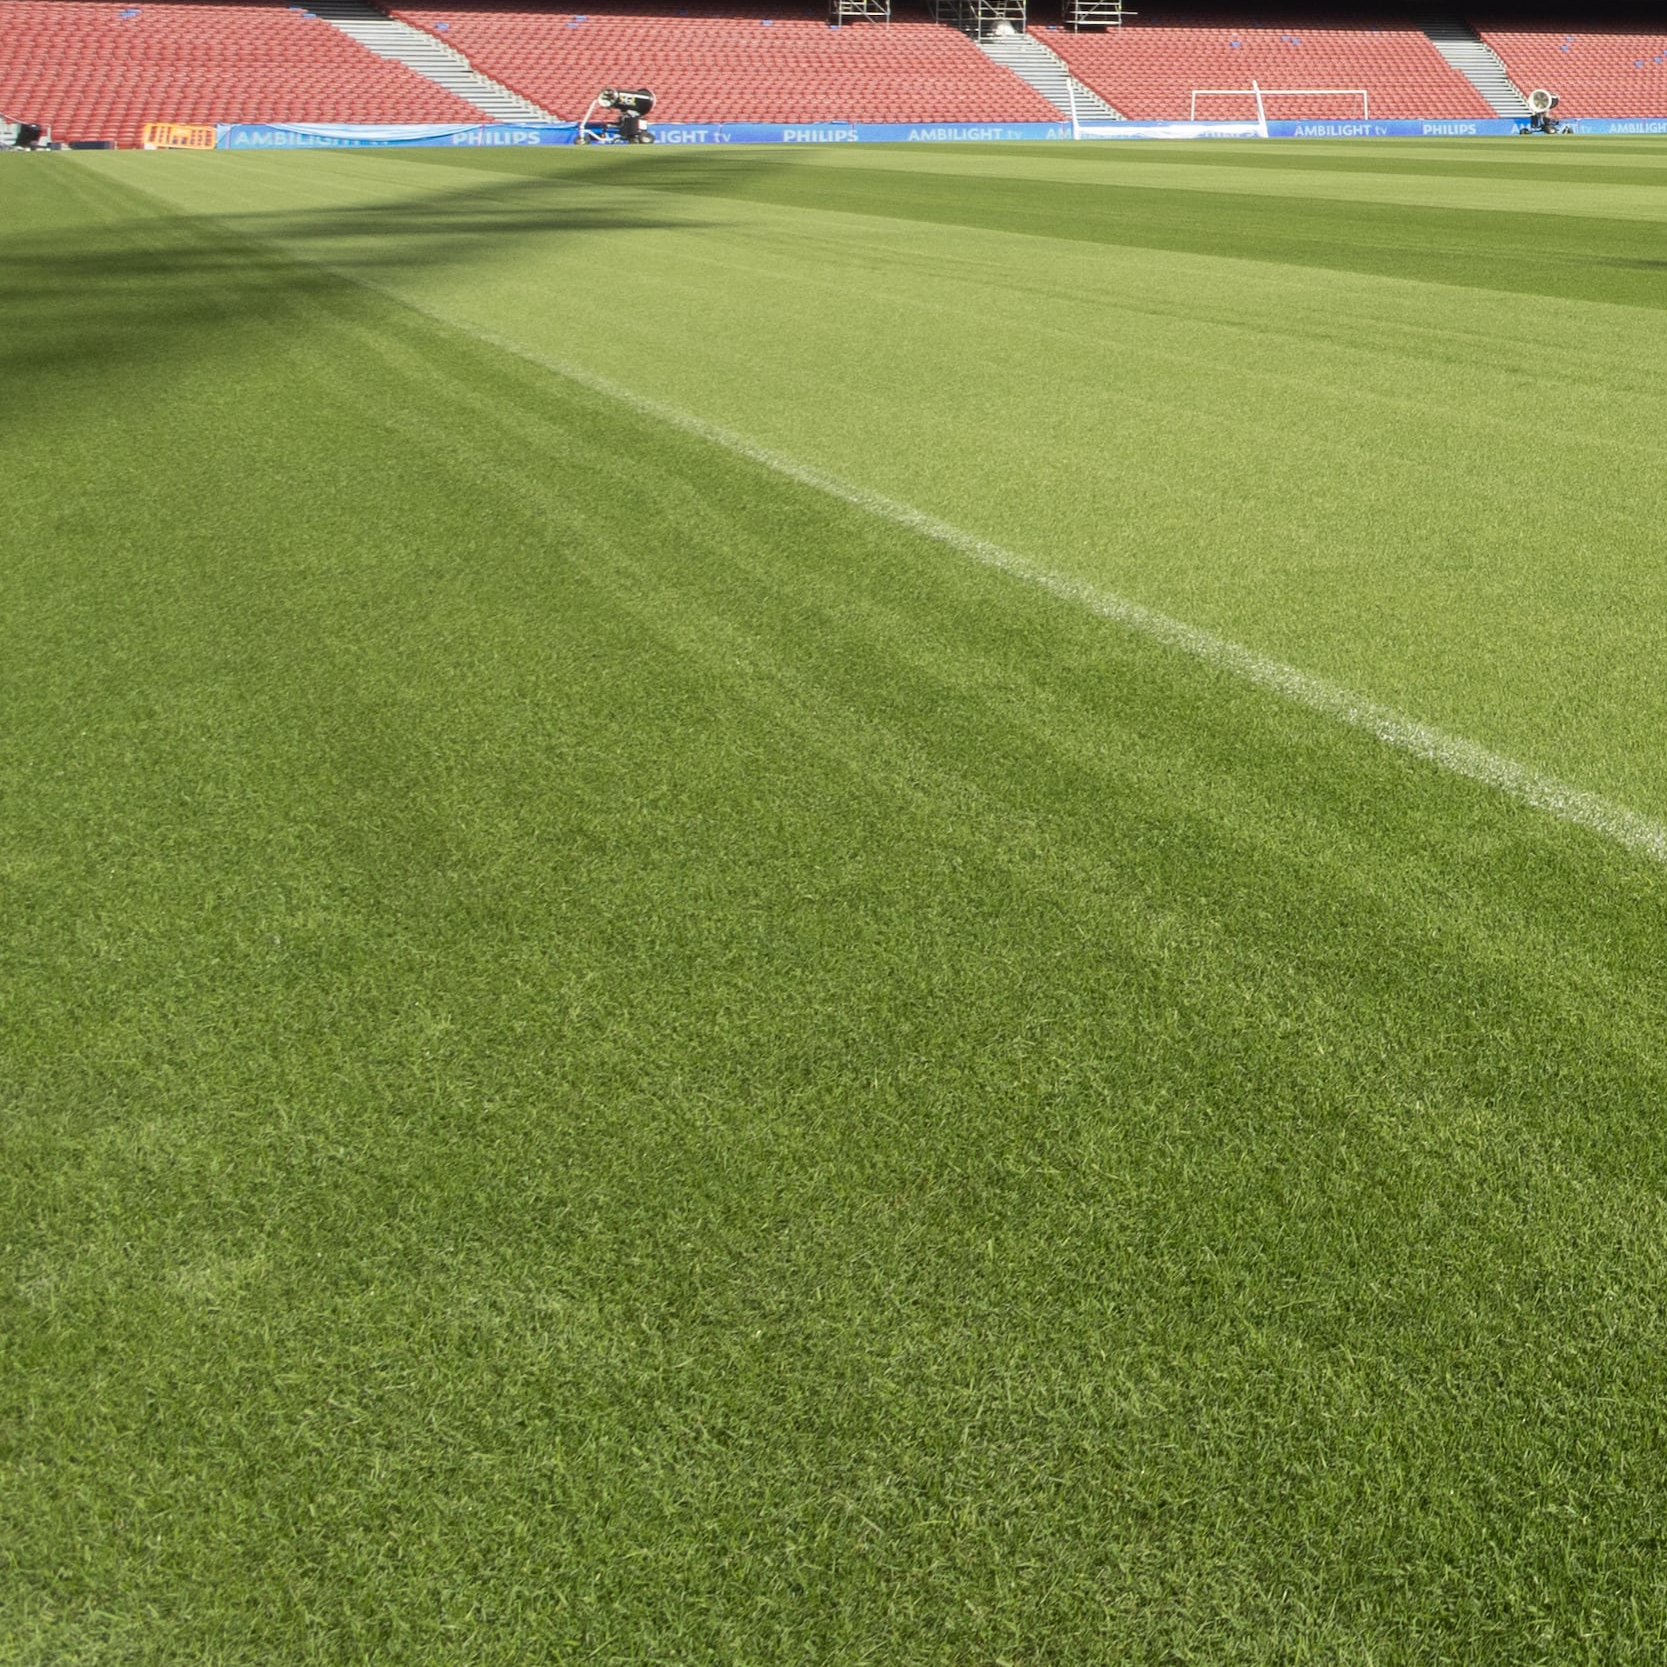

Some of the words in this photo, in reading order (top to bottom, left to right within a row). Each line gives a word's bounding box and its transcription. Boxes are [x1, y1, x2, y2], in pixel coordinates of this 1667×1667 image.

[907, 129, 1002, 141] AMBILIGHT
[1295, 124, 1371, 136] AMBILIGHT
[1374, 126, 1388, 136] tv
[1423, 124, 1476, 135] PHILIPS
[451, 130, 539, 145] PHILIPS
[714, 131, 732, 144] tv
[783, 130, 858, 143] PHILIPS
